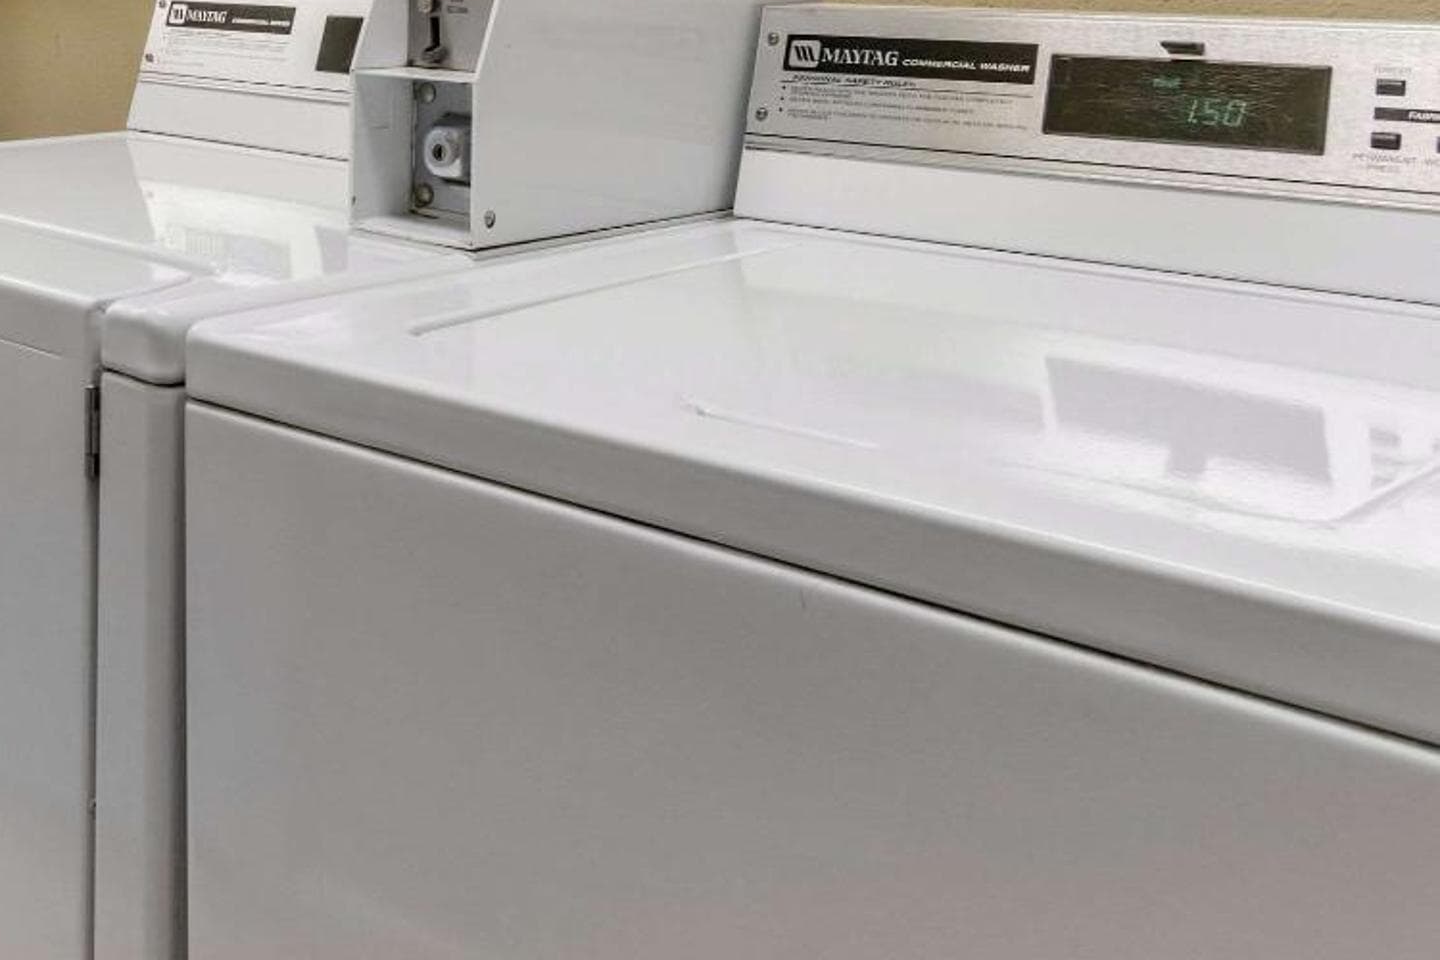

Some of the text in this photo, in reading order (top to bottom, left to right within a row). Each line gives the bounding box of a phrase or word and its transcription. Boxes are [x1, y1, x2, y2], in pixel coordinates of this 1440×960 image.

[186, 10, 228, 24] MAYTAG
[821, 47, 1031, 73] MAYTAG COMMERCIAL WASHER
